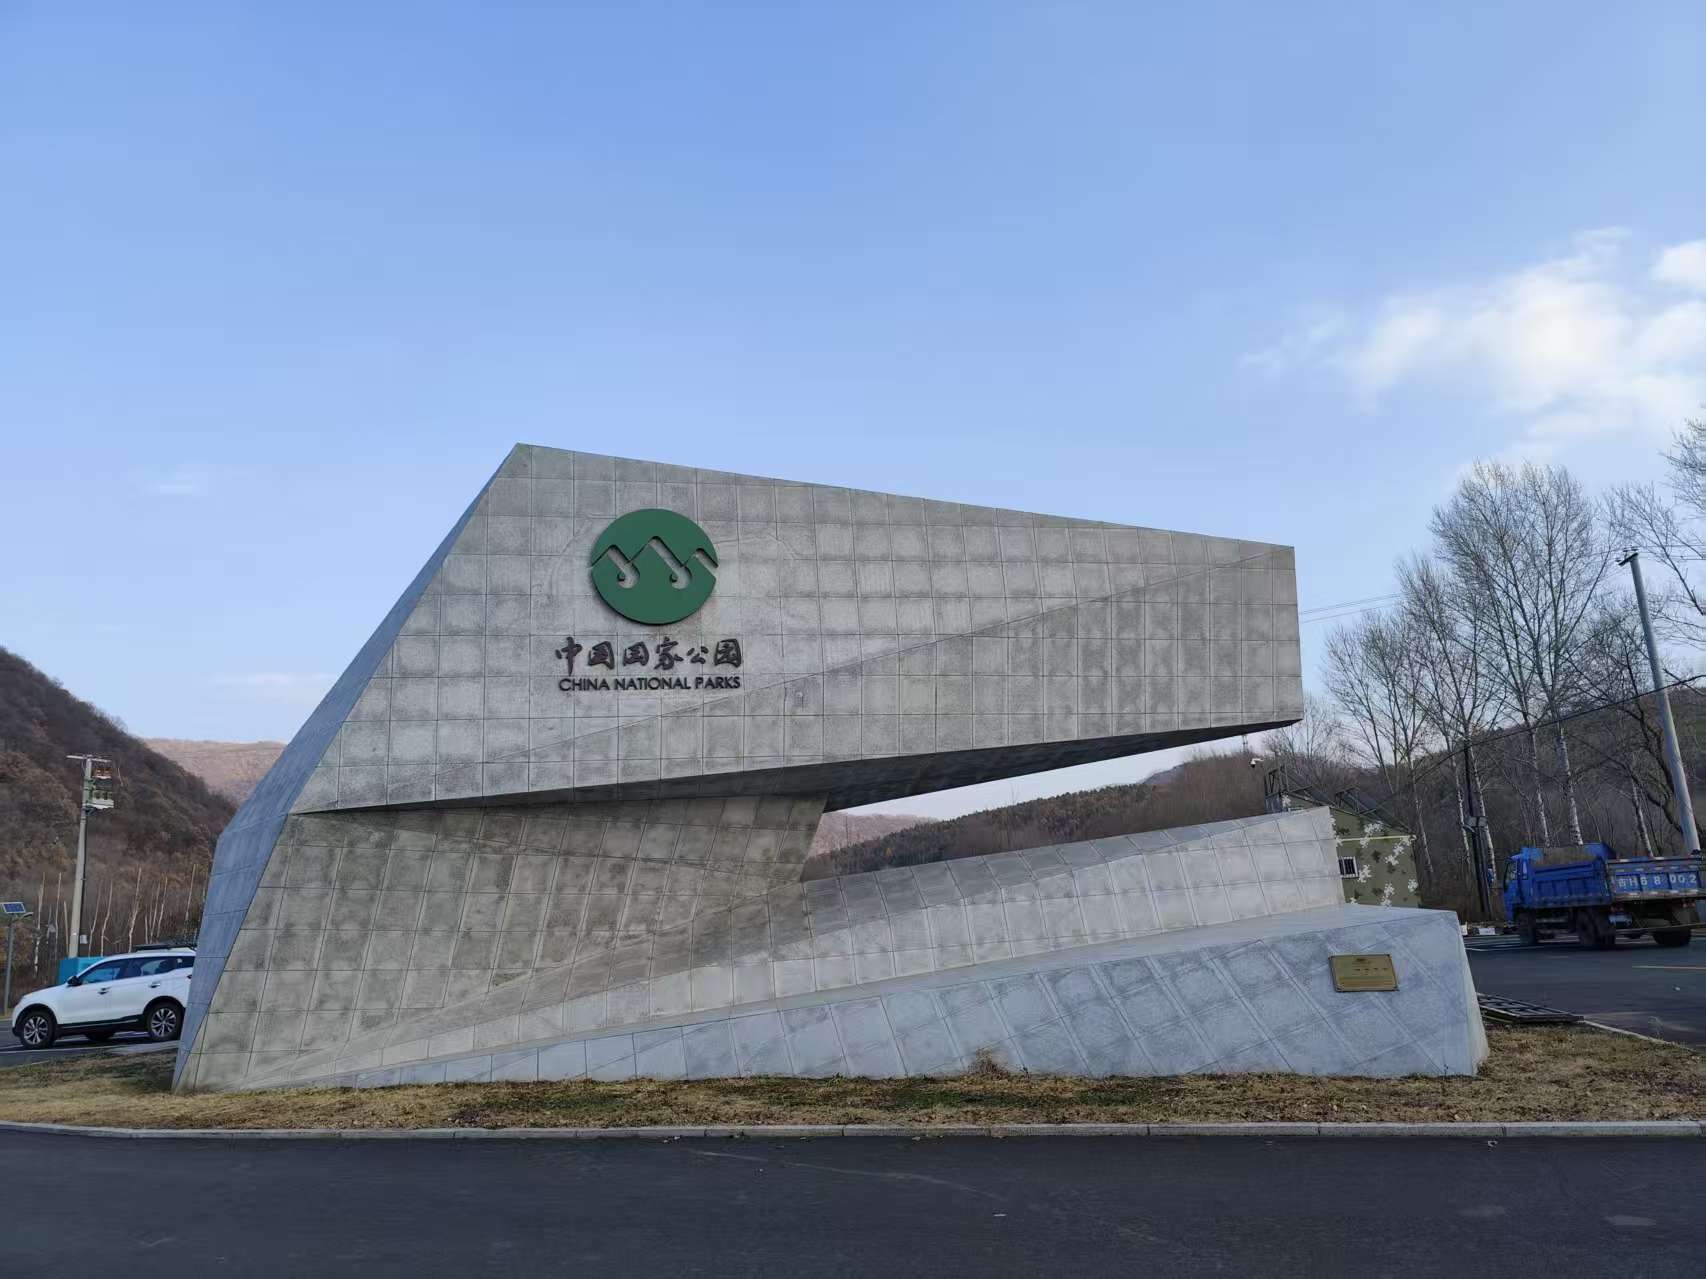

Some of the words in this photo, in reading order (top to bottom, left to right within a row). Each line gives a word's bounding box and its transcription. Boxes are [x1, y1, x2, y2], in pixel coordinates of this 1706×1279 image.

[555, 636, 742, 677] 中国国家公园
[559, 677, 611, 692] CHINA
[614, 676, 691, 691] NATIONAL
[695, 676, 741, 690] PARKS
